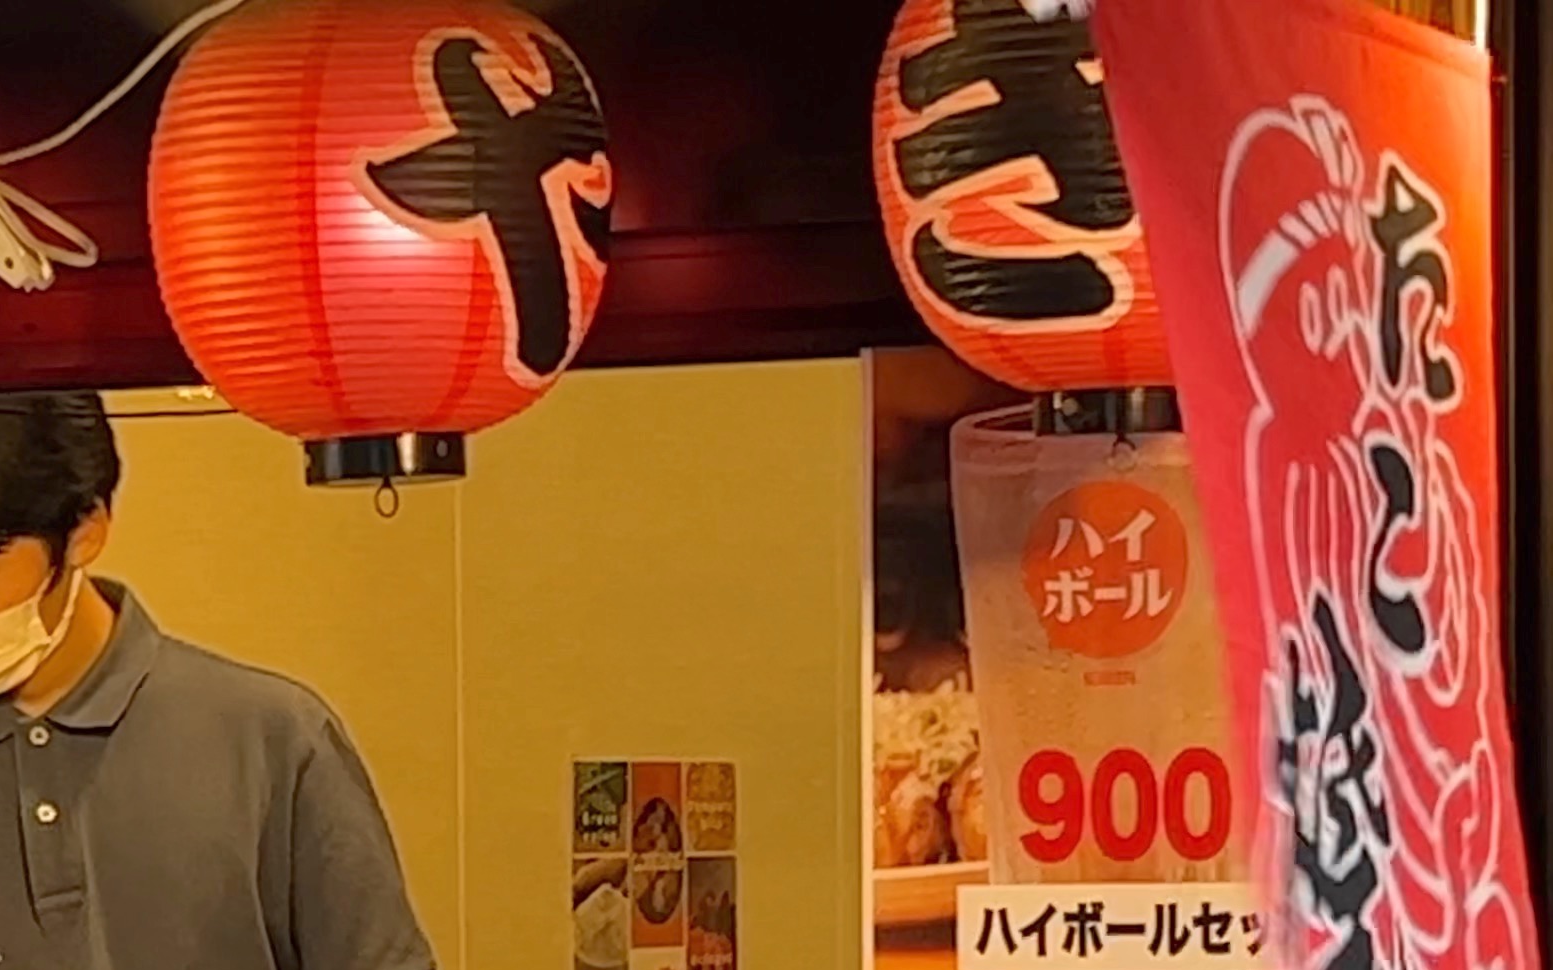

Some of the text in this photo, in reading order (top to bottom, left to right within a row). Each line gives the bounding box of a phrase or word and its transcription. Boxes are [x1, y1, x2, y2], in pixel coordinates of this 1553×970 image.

[353, 26, 613, 386] や
[1050, 510, 1156, 562] ハイ
[1043, 566, 1172, 622] ボール
[1019, 748, 1232, 863] 900
